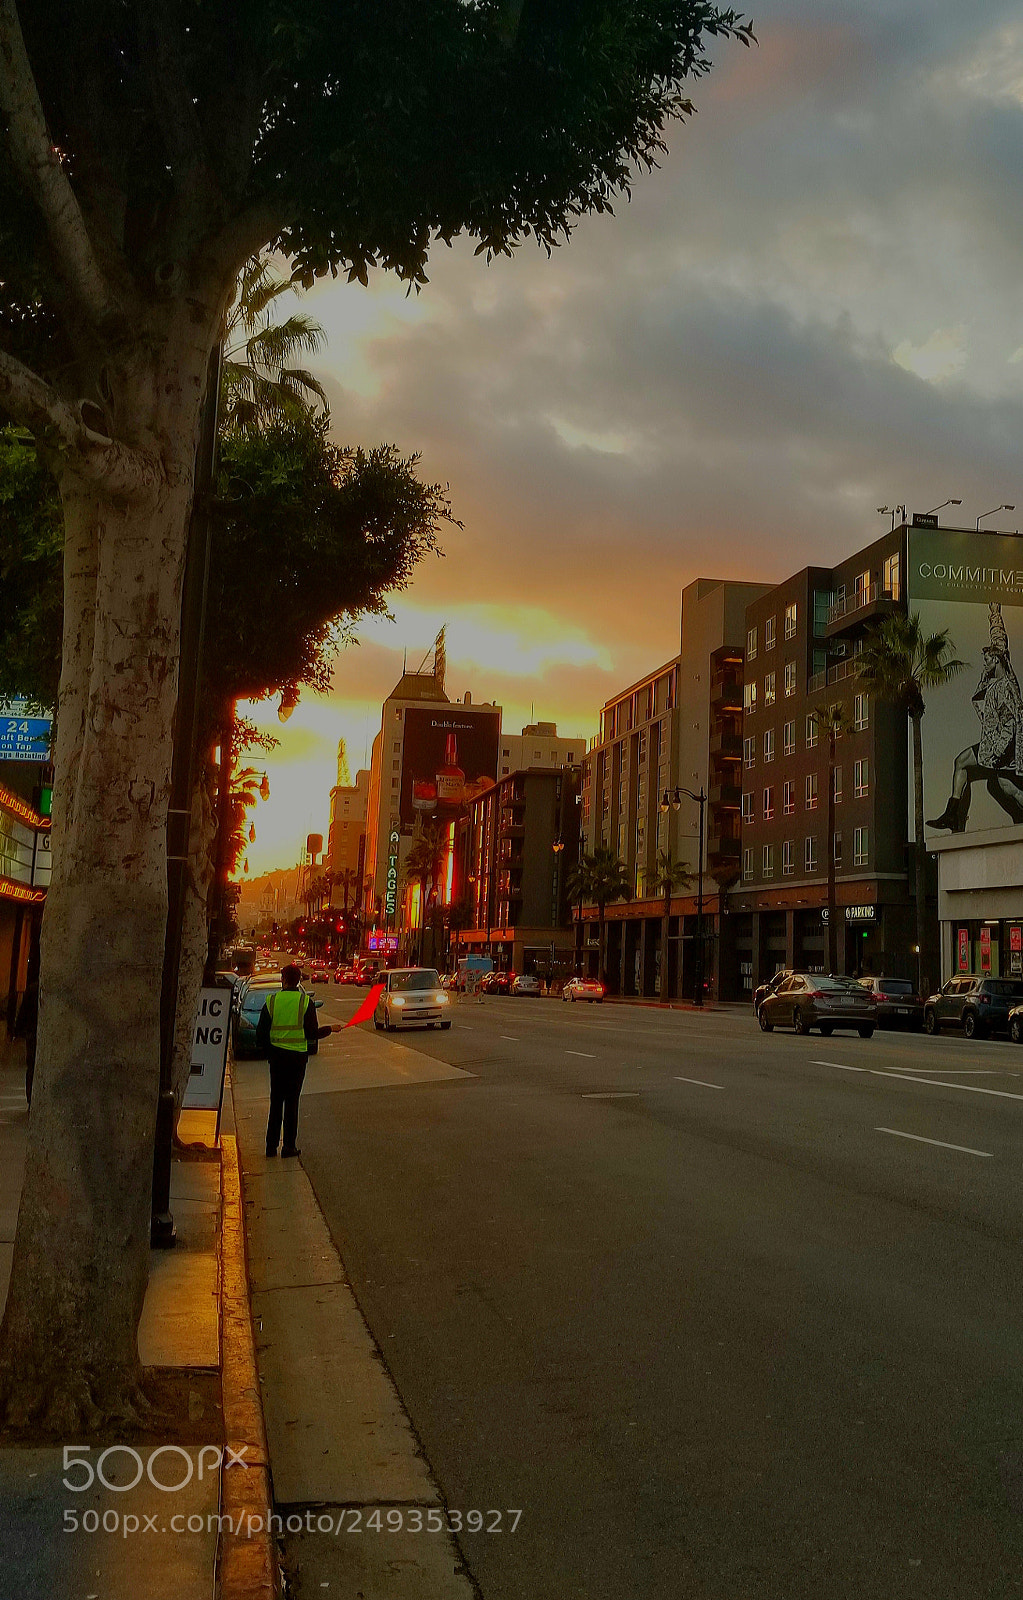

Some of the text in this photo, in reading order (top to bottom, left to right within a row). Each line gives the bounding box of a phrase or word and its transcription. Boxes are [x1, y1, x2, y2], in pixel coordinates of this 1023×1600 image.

[6, 720, 29, 734] 24
[15, 742, 32, 751] Tap
[42, 834, 50, 849] G
[851, 905, 874, 919] PARKING
[197, 999, 223, 1017] IC
